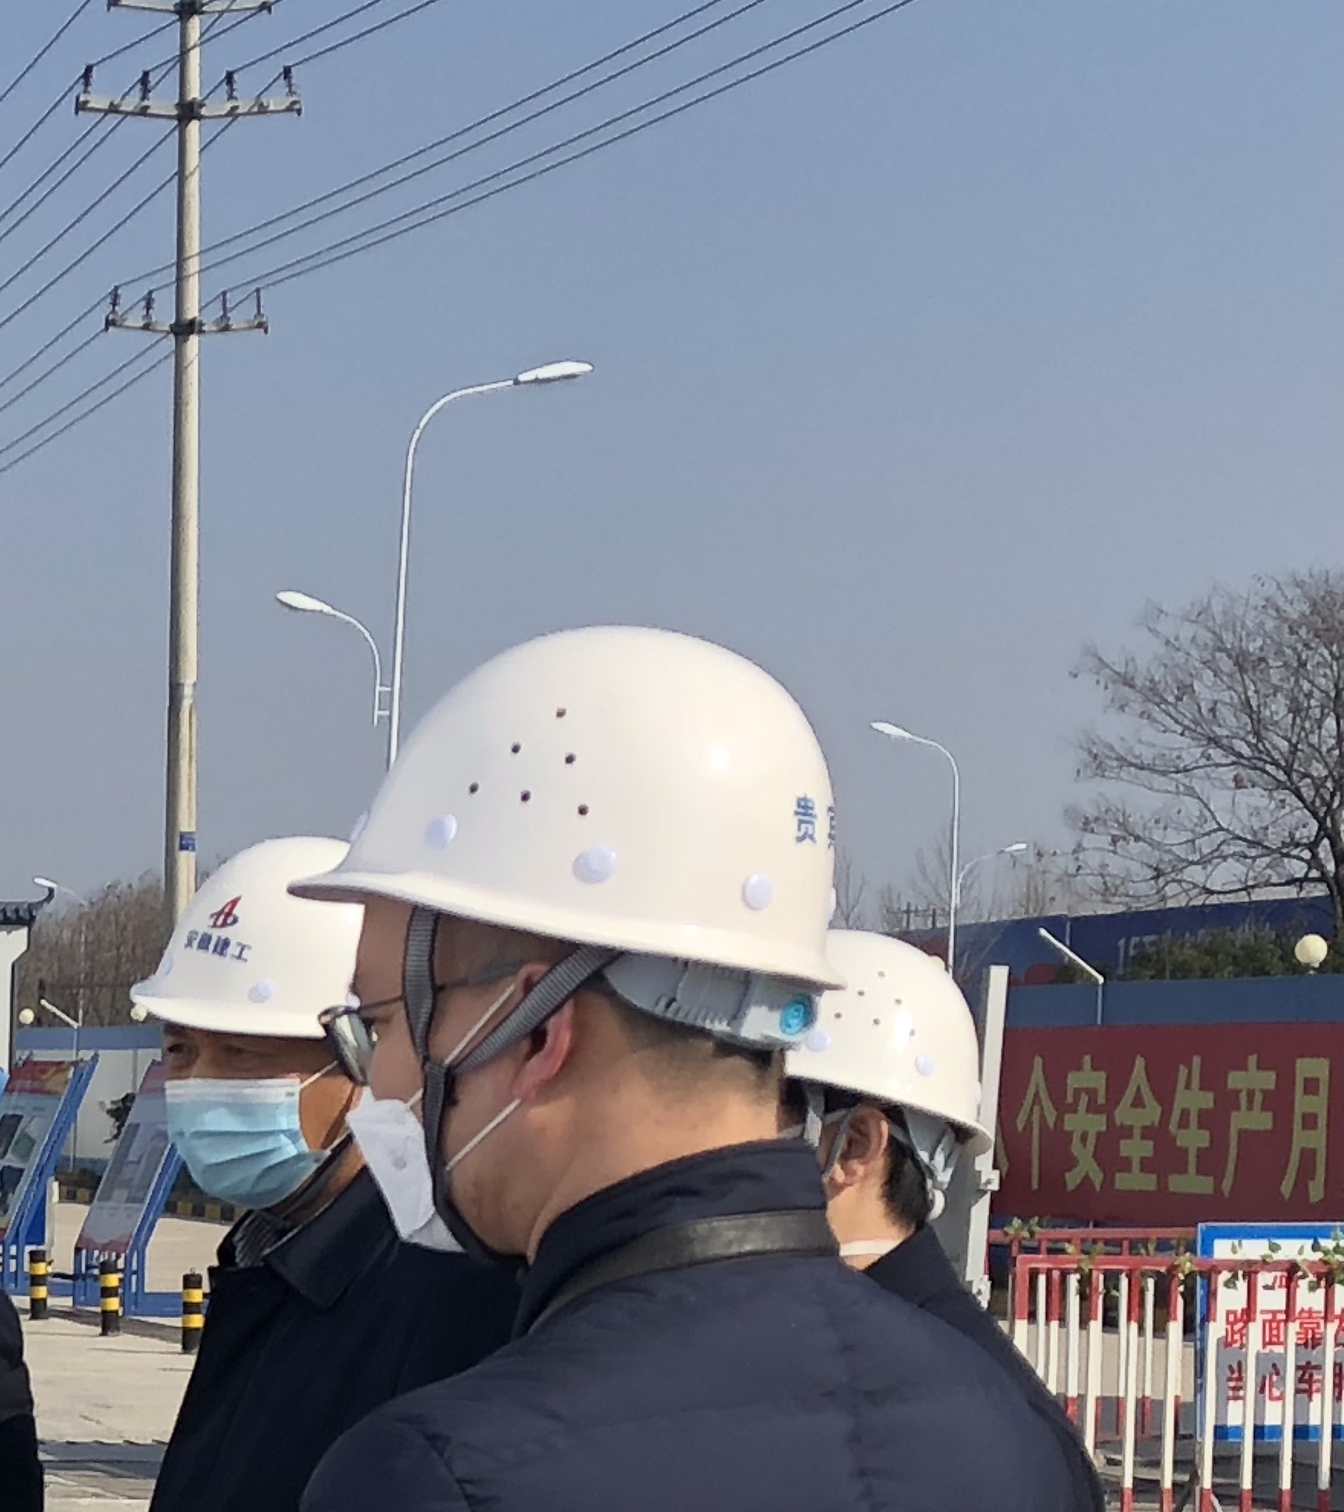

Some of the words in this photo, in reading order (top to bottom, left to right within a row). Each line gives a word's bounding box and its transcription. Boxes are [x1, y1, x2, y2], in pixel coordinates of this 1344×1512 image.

[993, 1053, 1332, 1202] 个安全生产月
